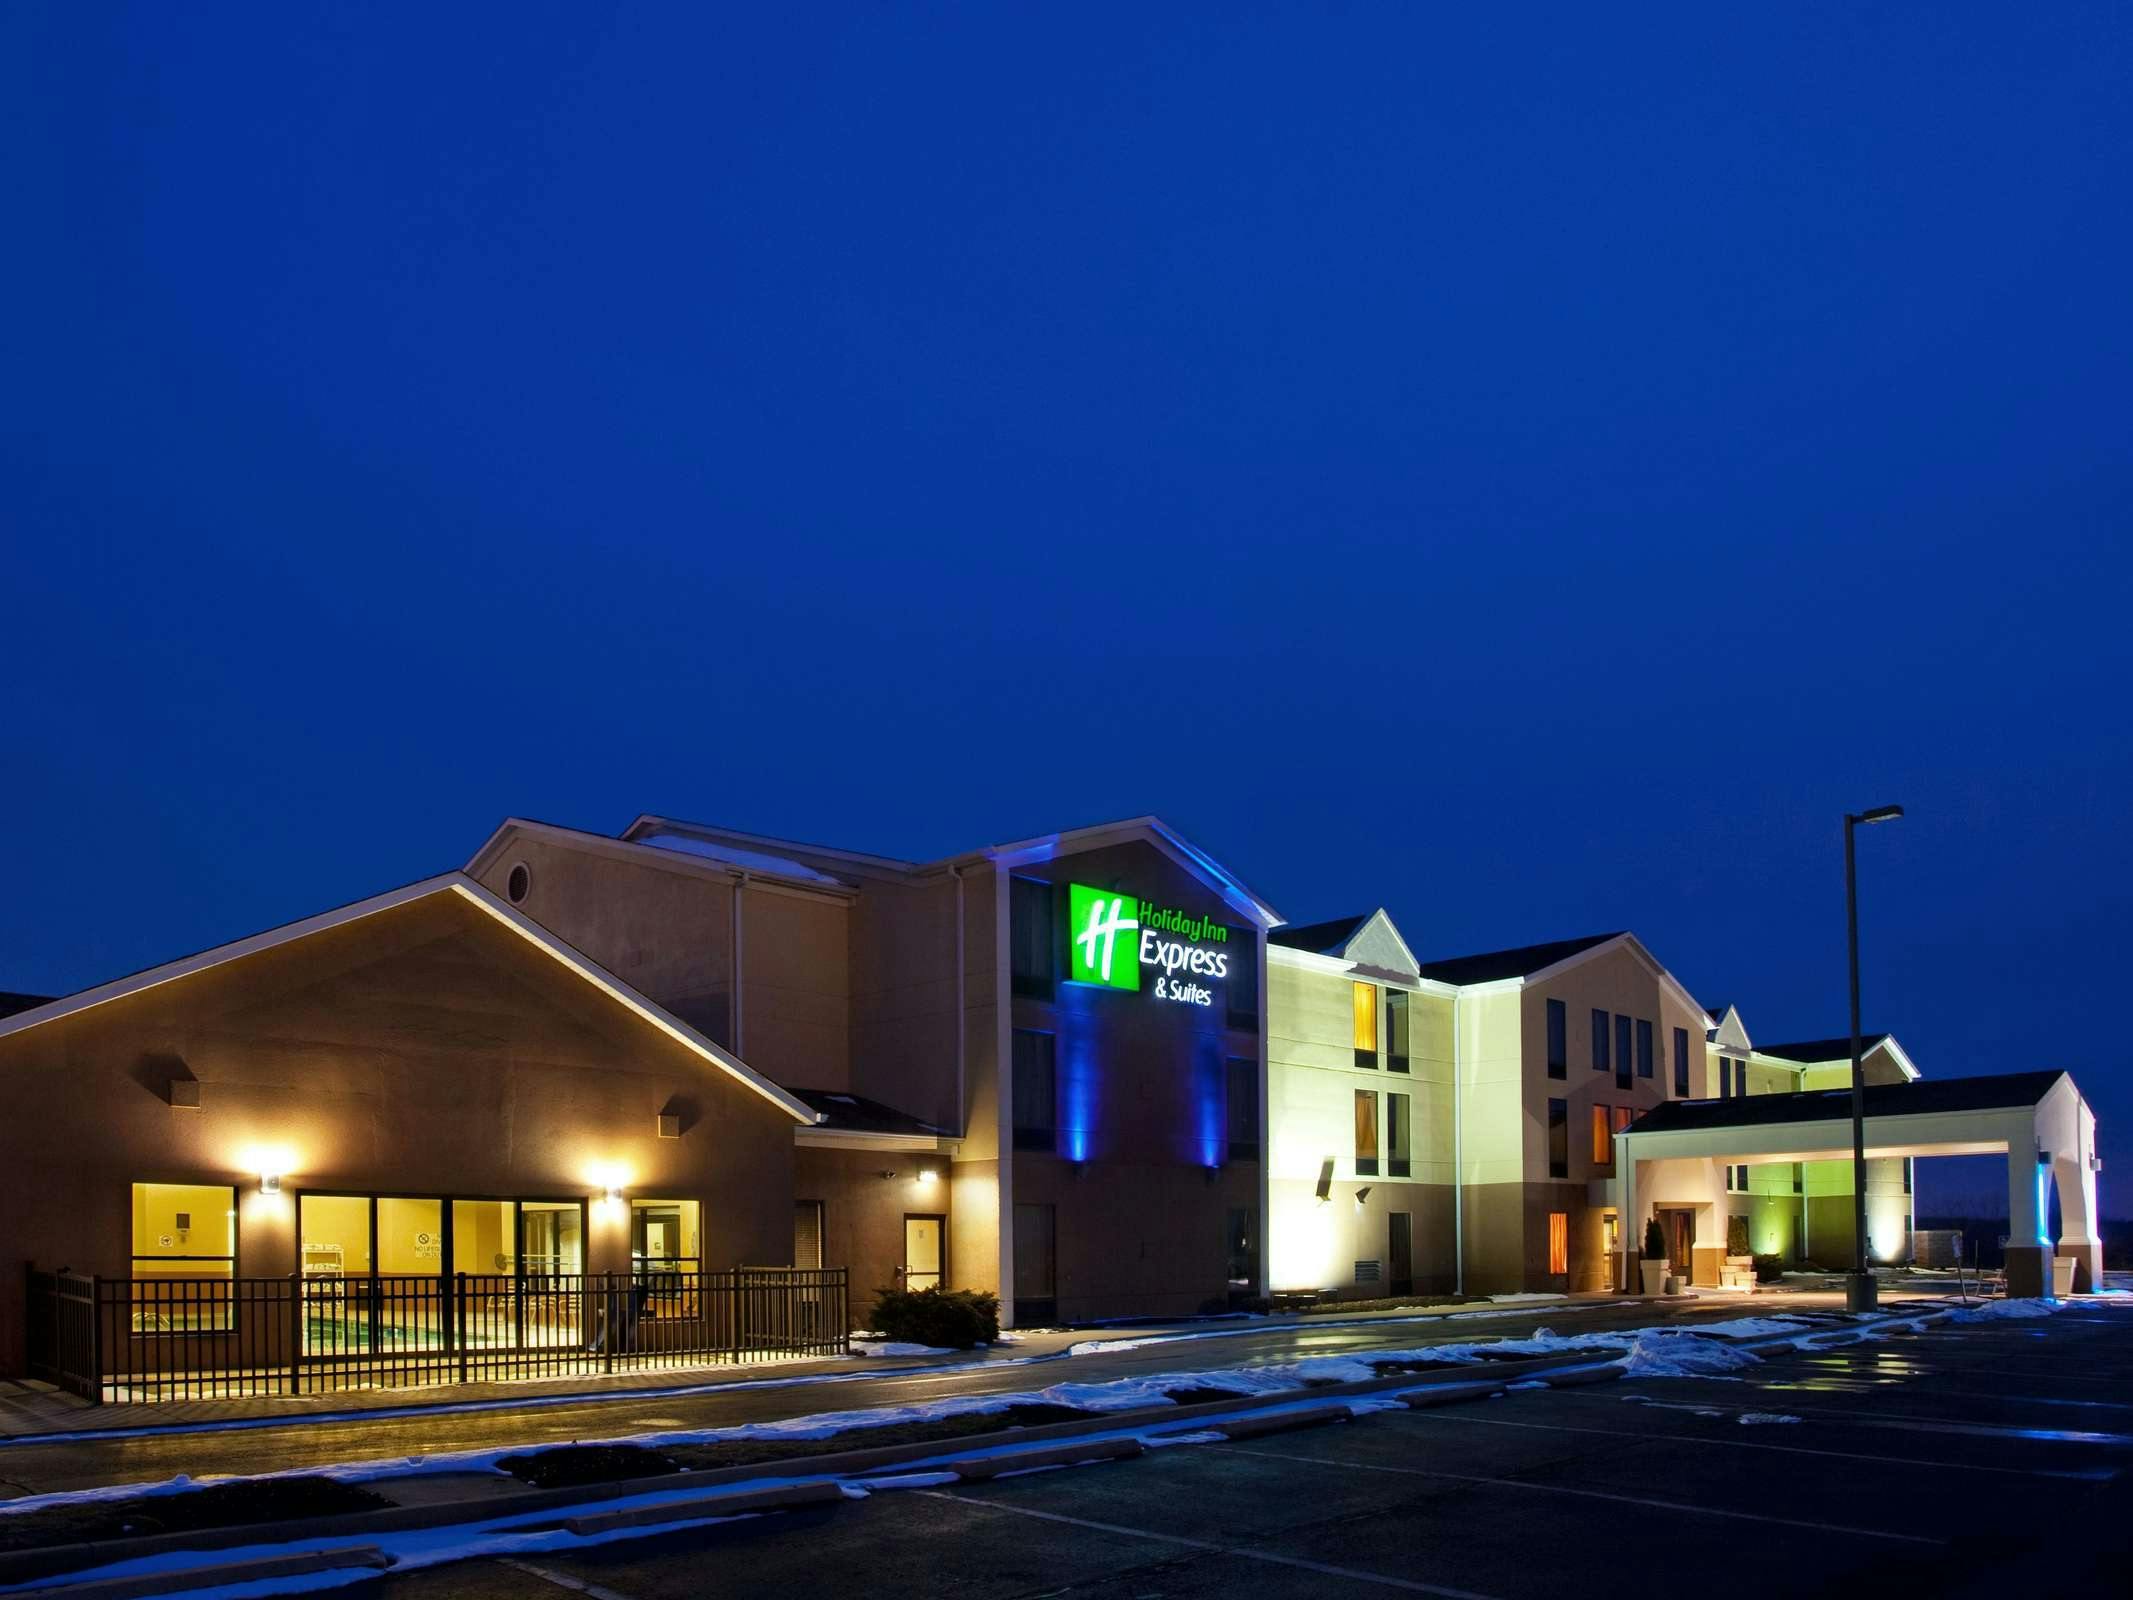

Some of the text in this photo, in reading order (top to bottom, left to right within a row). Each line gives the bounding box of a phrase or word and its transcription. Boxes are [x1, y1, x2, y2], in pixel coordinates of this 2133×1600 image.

[1139, 901, 1227, 943] Holiday Inn
[1139, 929, 1228, 978] Express
[1155, 976, 1212, 1006] & Suites
